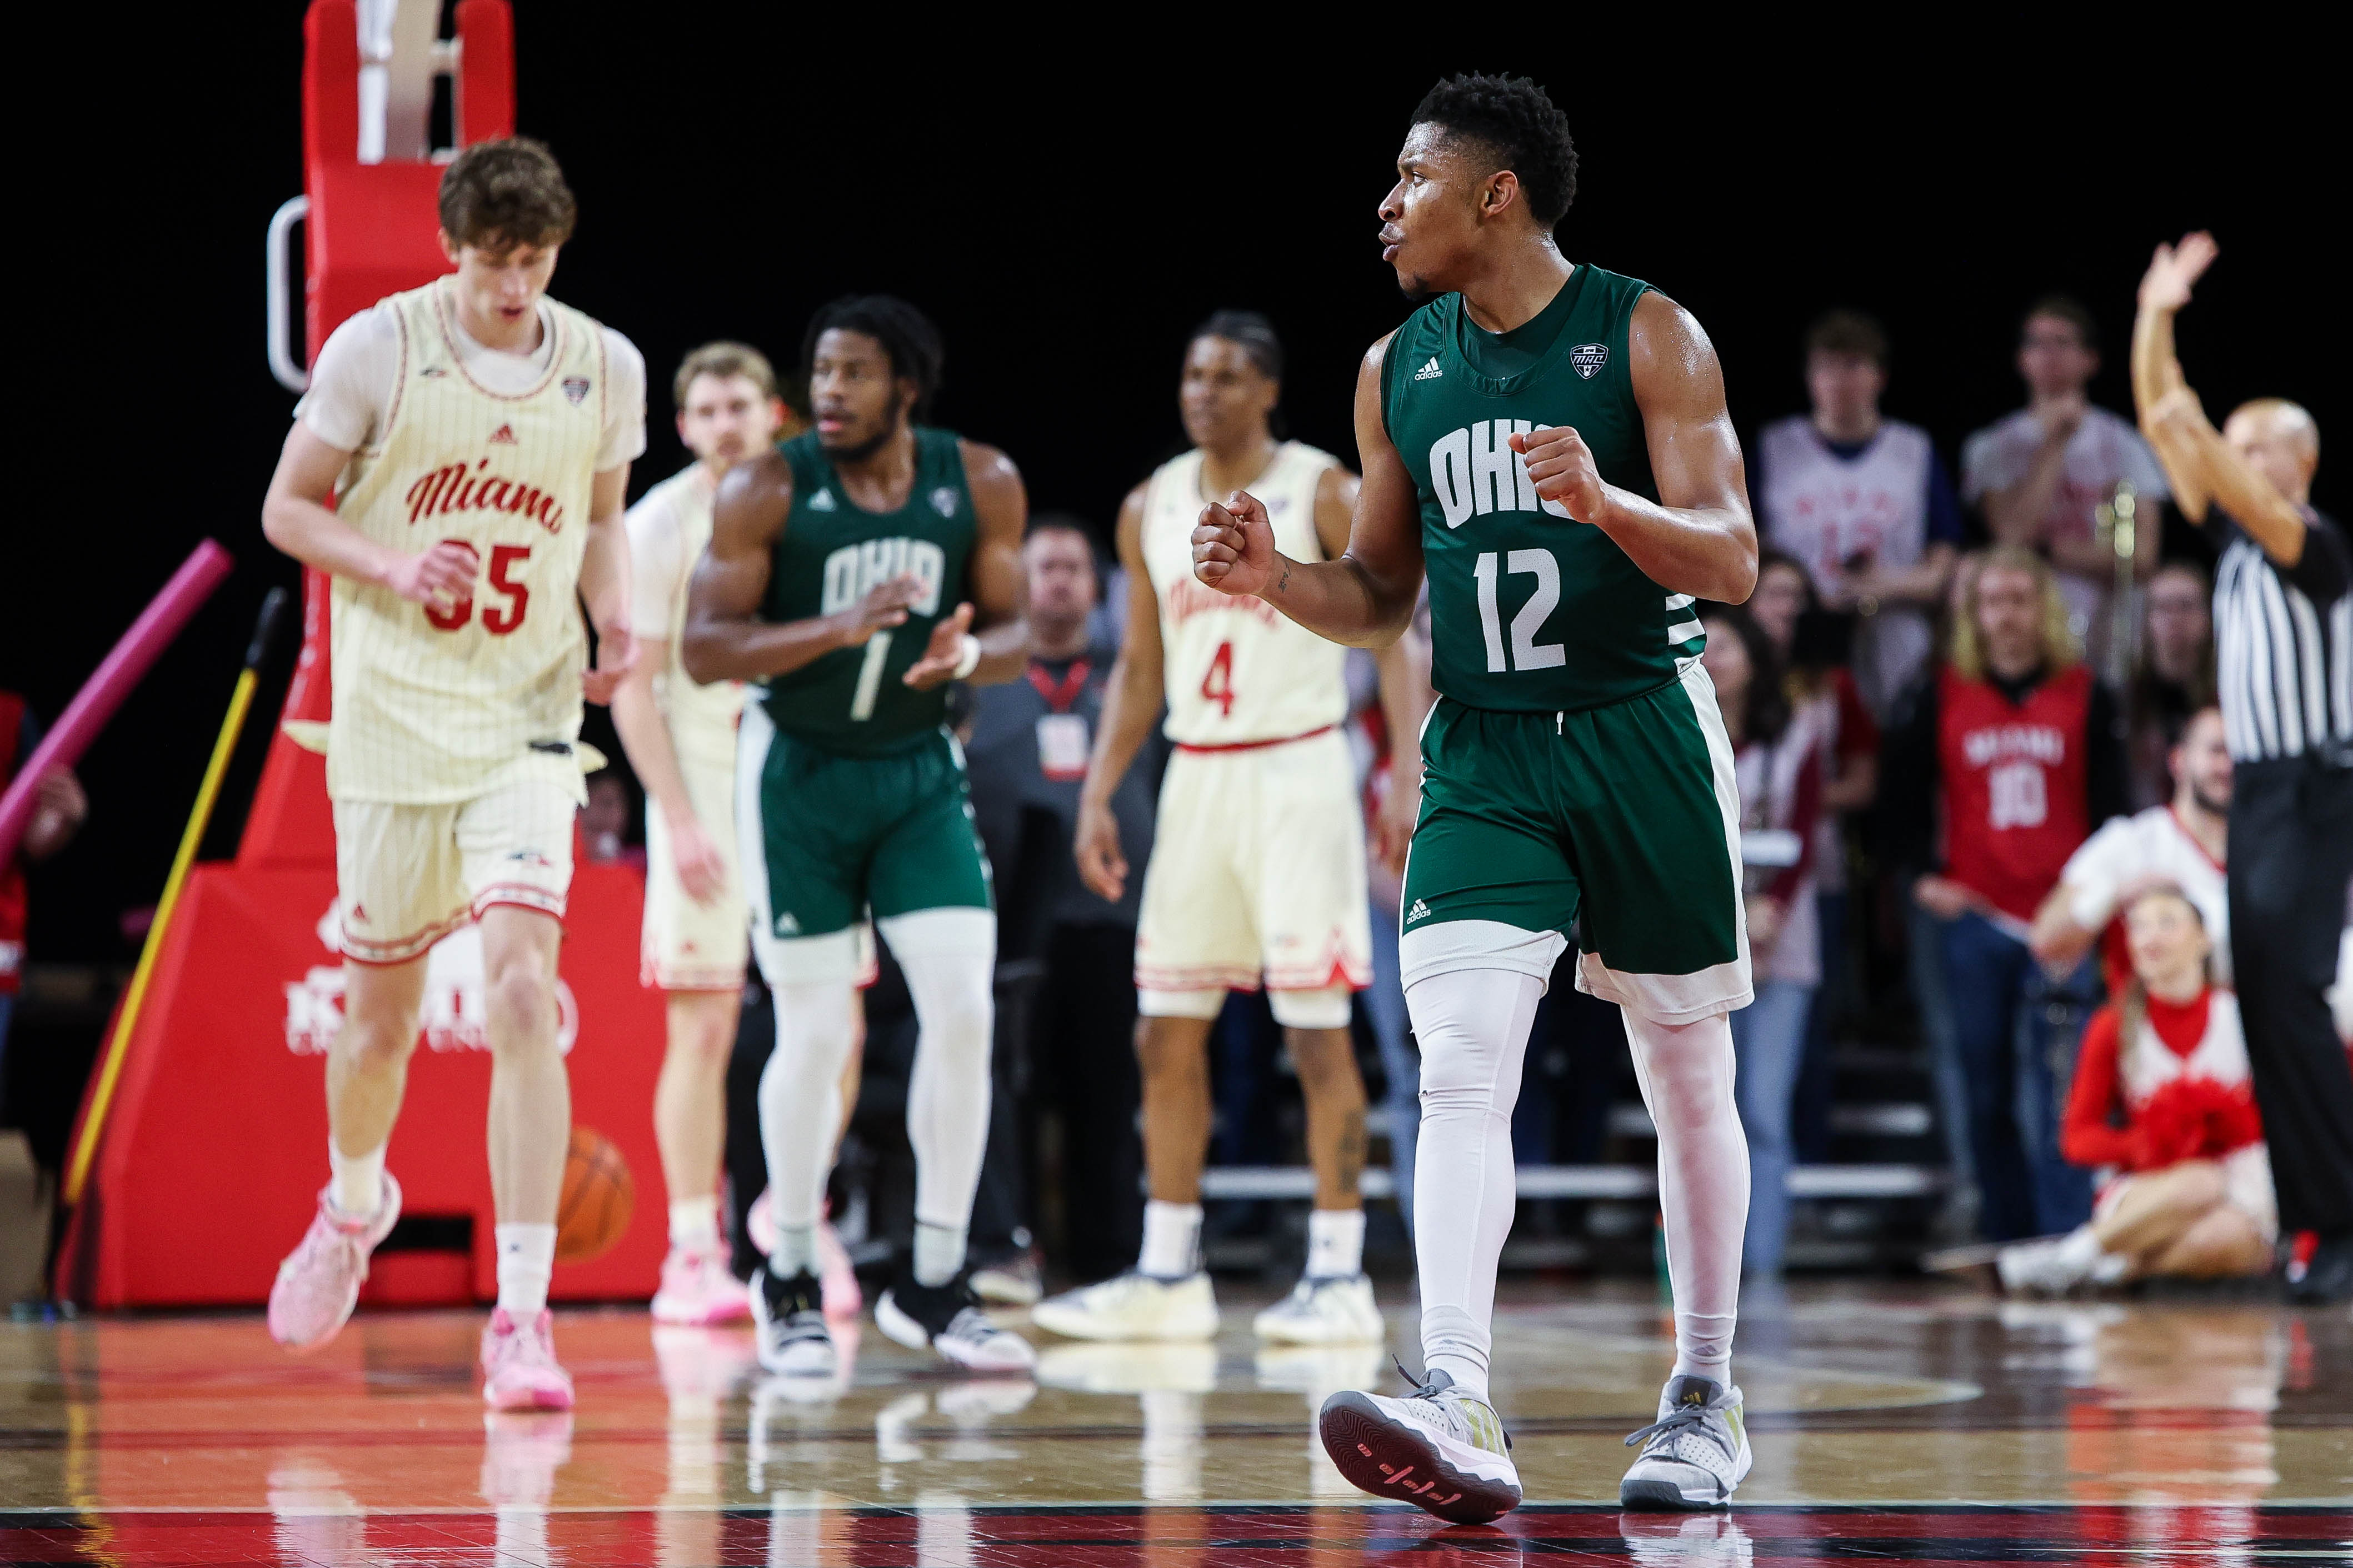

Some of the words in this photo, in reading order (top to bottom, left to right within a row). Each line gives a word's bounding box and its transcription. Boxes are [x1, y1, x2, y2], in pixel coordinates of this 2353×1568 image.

[1415, 370, 1443, 380] adidas
[1573, 355, 1605, 364] MAC
[406, 458, 563, 534] Miami
[1430, 419, 1574, 529] OHI
[1473, 548, 1566, 673] 12
[1201, 639, 1236, 718] 4
[1989, 763, 2048, 830] 10
[1407, 909, 1431, 925] adidas
